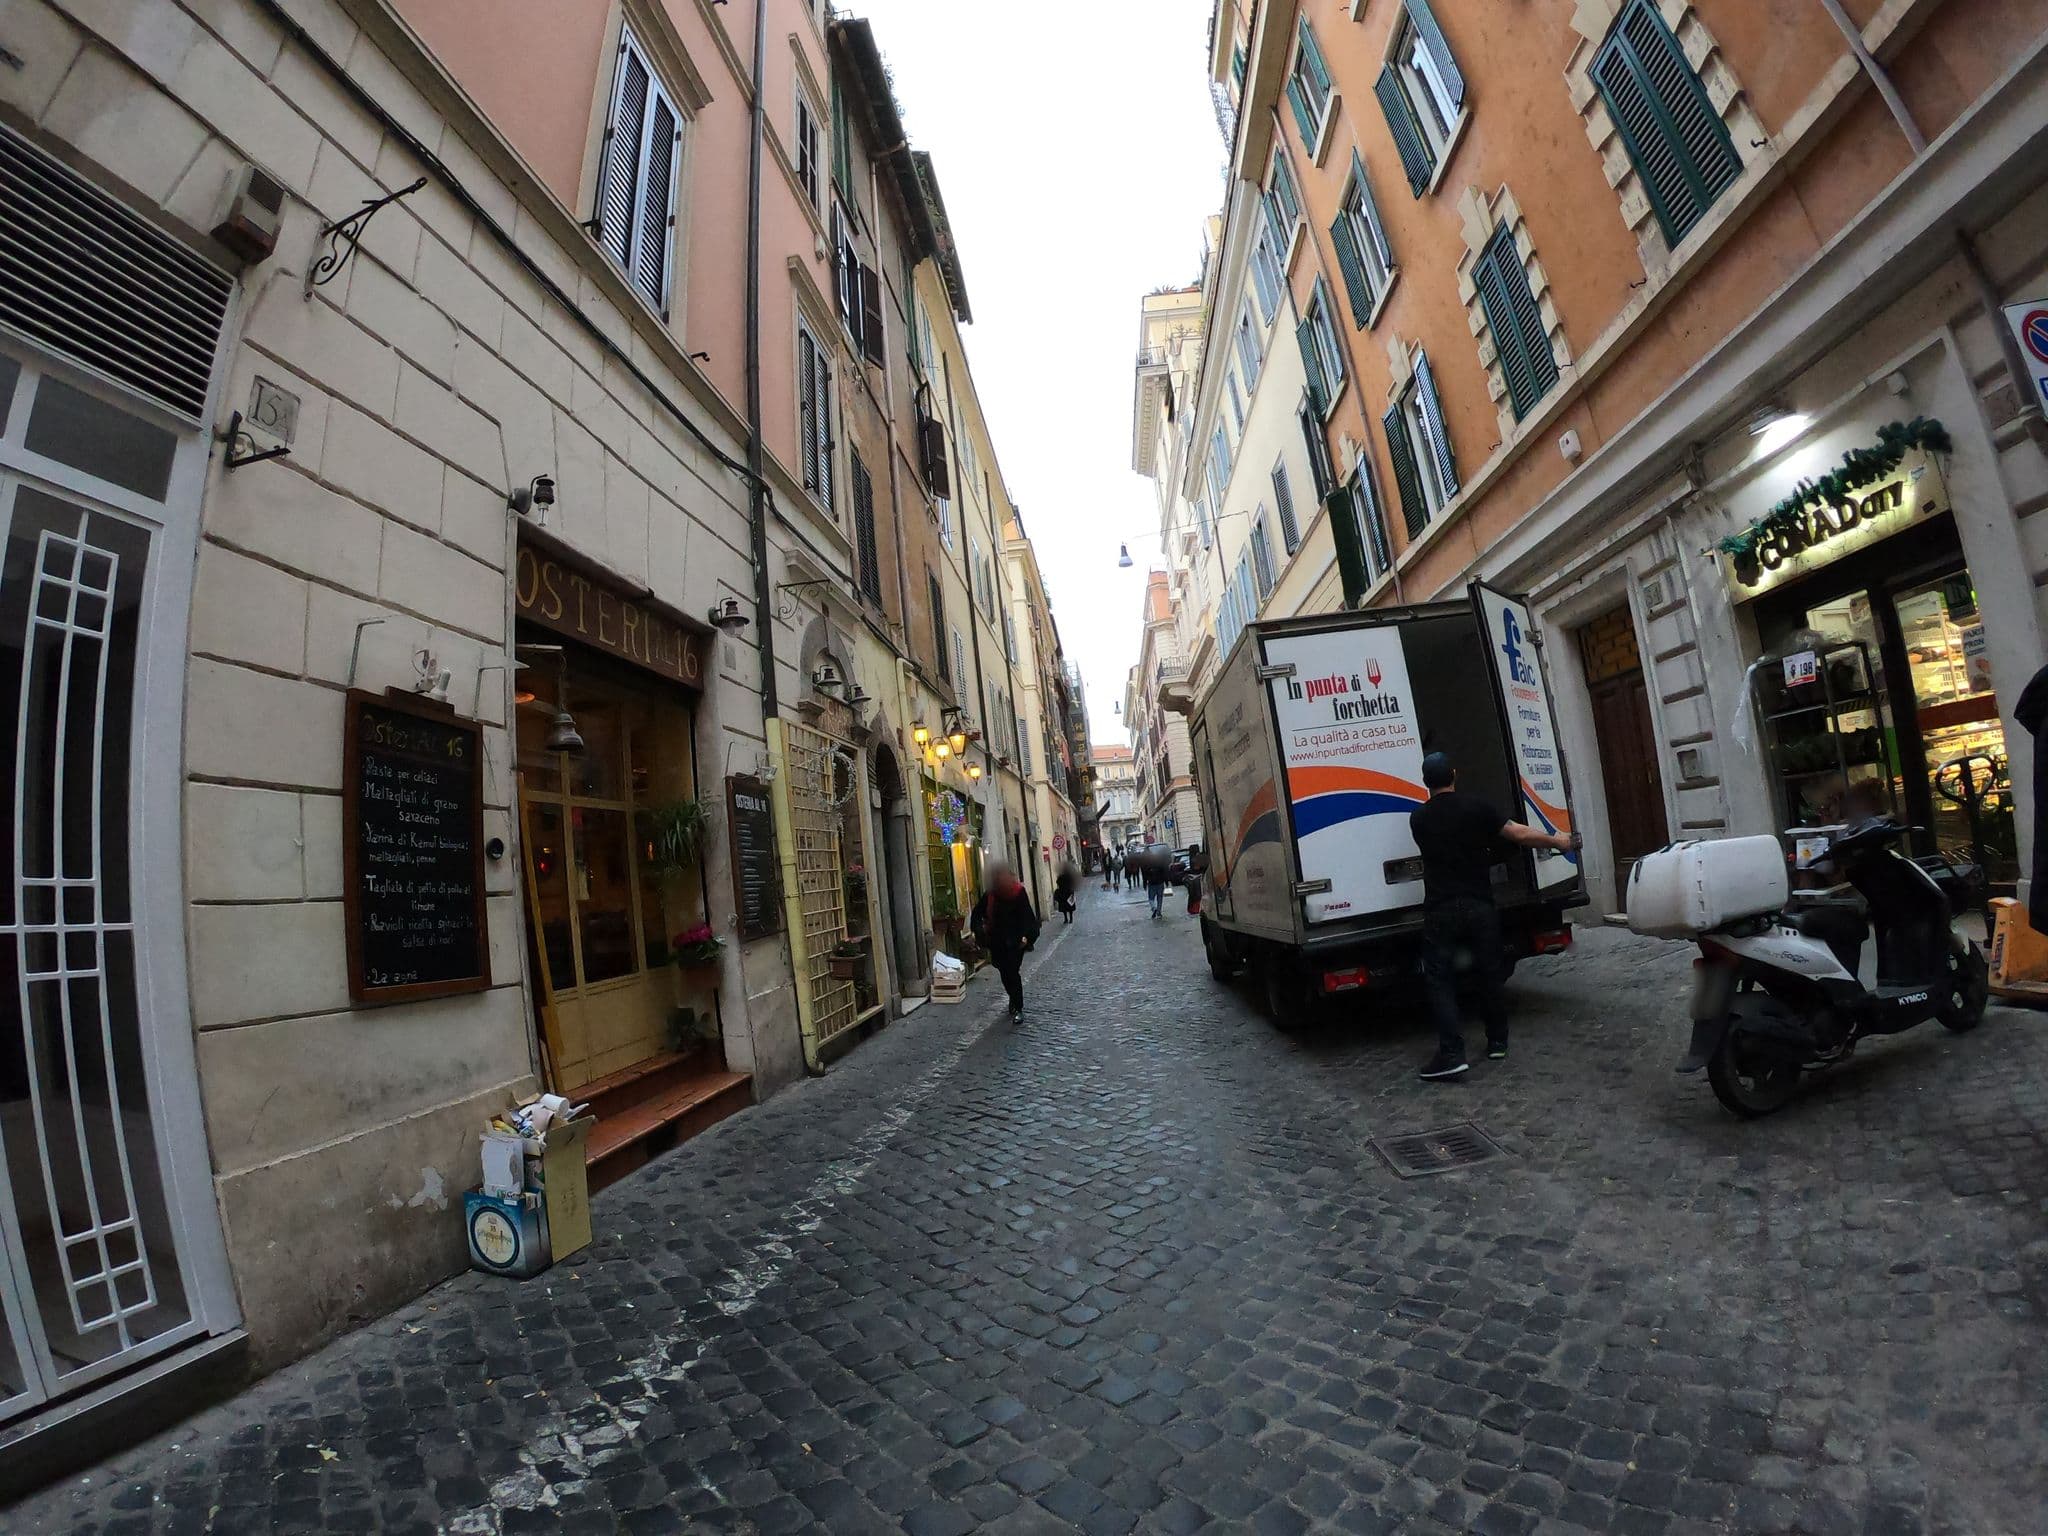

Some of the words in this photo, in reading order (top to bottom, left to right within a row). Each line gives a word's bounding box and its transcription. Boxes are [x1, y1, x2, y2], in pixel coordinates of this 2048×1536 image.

[1285, 676, 1303, 701] In
[1305, 672, 1349, 703] punta
[1351, 674, 1361, 692] di
[1332, 691, 1401, 721] forchetta
[1294, 735, 1308, 748] La
[1310, 728, 1350, 748] qualità
[1352, 730, 1359, 740] a
[1361, 725, 1386, 739] casa
[1388, 723, 1407, 735] tua
[1289, 737, 1416, 762] www.inpuntadiforchetta.com
[421, 791, 430, 805] di
[1898, 992, 1928, 1006] KYMCO
